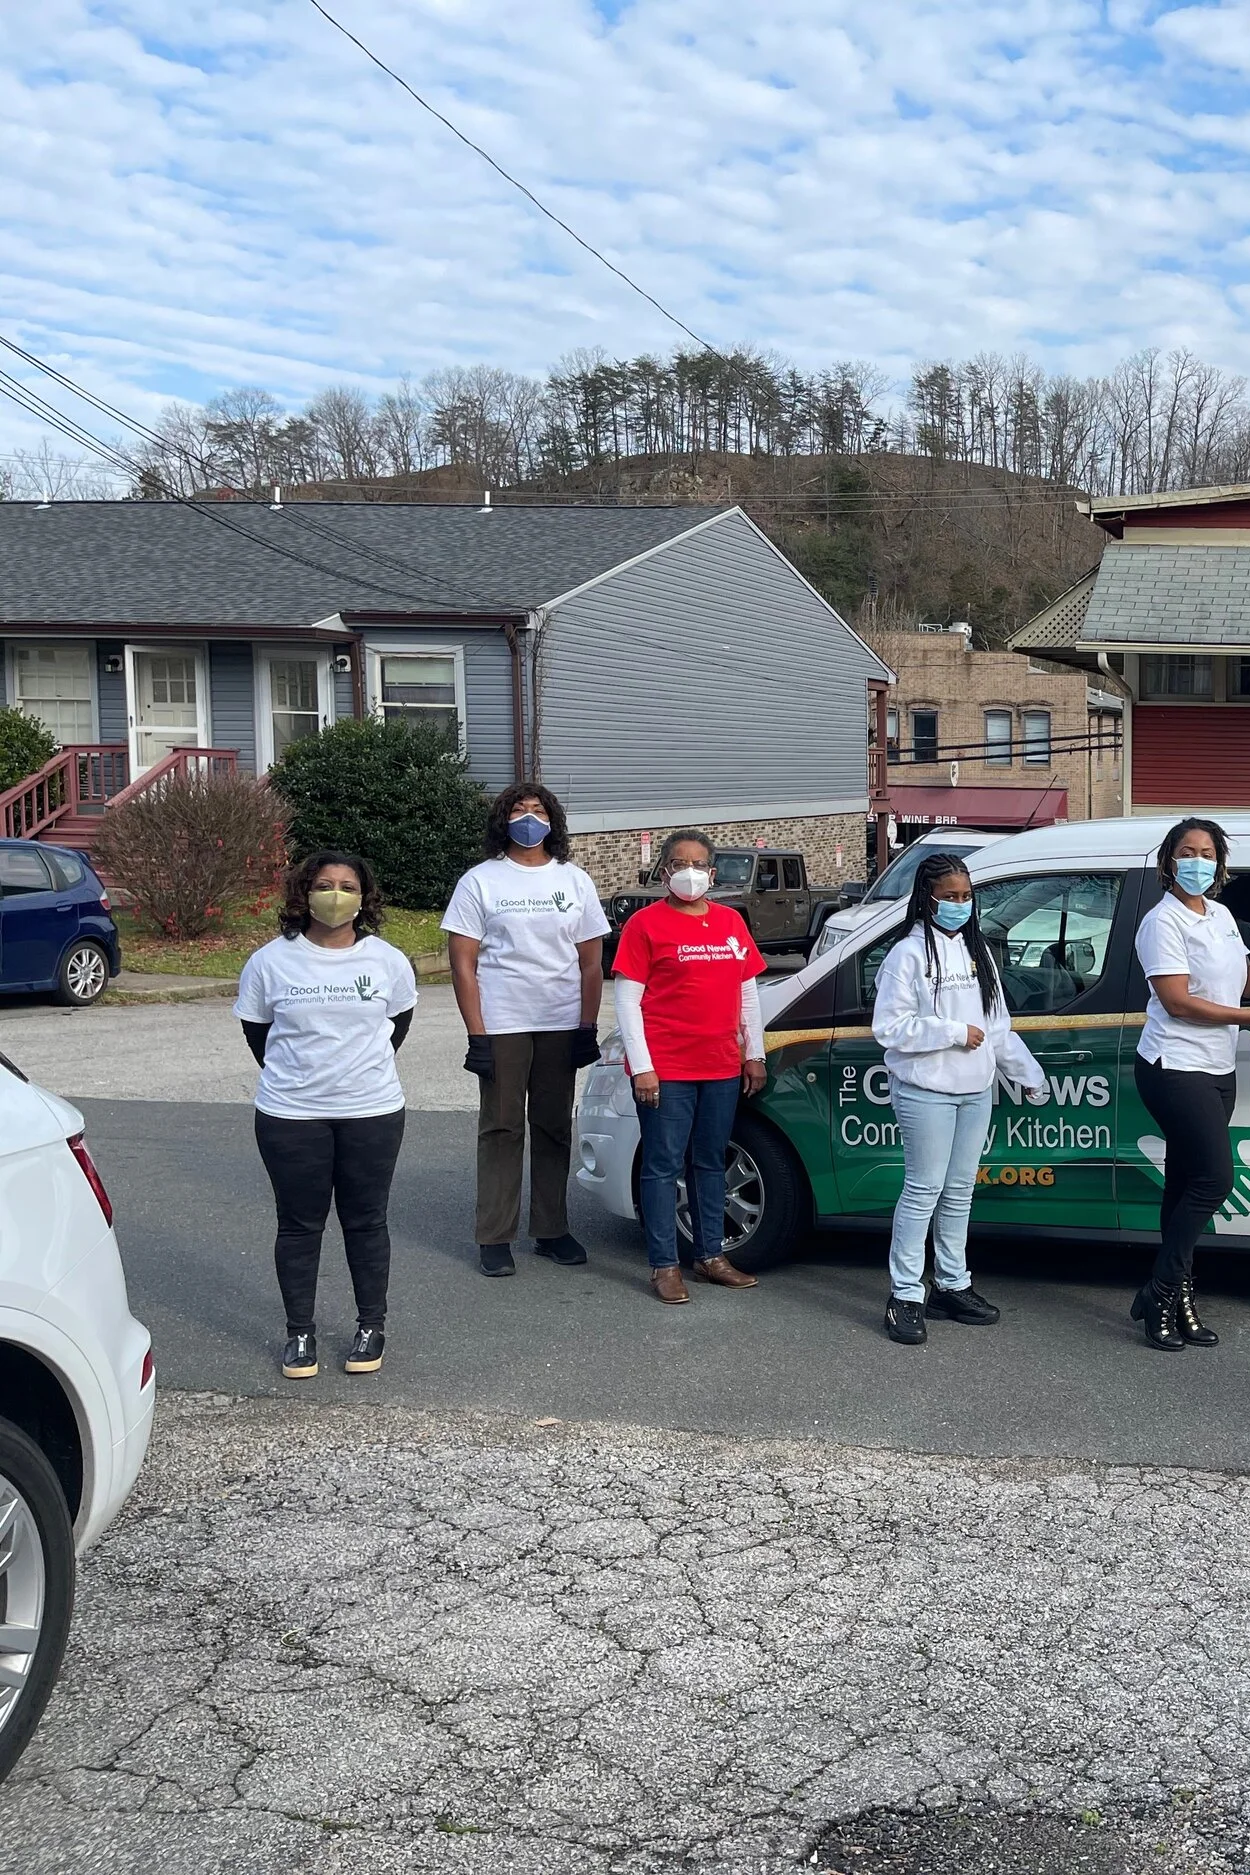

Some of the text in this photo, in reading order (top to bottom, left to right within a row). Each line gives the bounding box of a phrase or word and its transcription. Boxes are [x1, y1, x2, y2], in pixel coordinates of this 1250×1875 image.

[866, 814, 958, 825] STP WINE BAR
[500, 899, 526, 907] Good
[495, 907, 531, 915] Community
[678, 953, 711, 962] Community
[290, 986, 320, 996] Good
[323, 985, 356, 994] News
[284, 995, 356, 1006] Community Kitchen
[839, 1065, 857, 1107] The
[1006, 1116, 1112, 1149] Kitchen
[976, 1166, 1055, 1186] K.ORG
